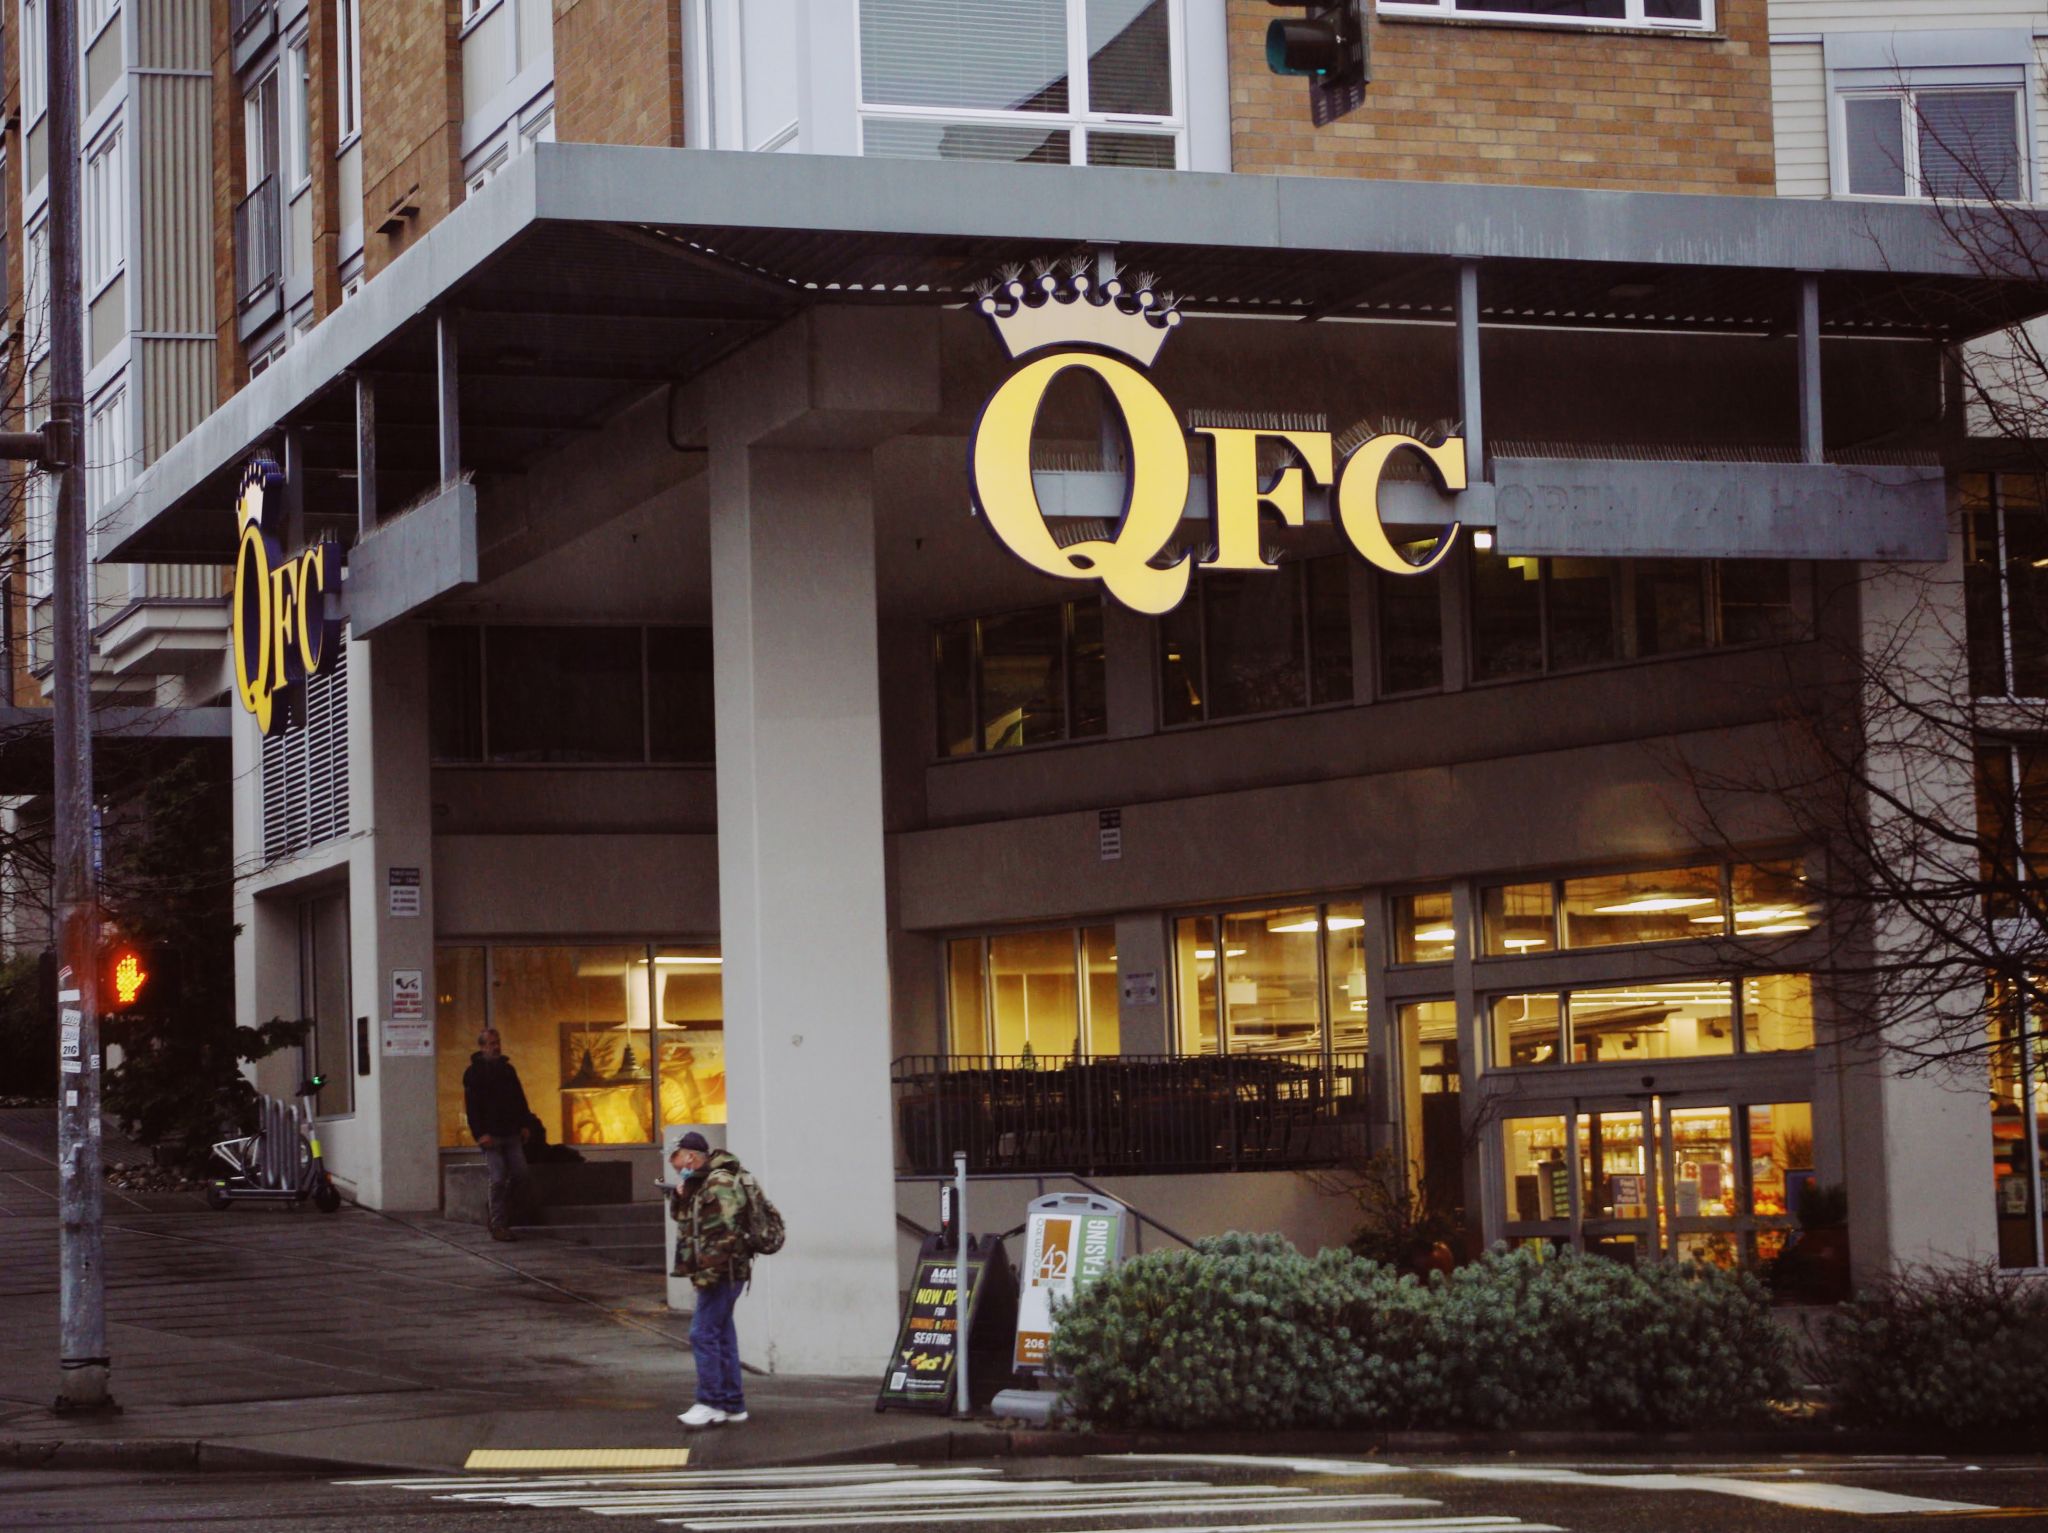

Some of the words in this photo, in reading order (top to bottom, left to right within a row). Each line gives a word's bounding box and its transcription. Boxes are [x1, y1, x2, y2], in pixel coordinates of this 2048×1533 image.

[971, 351, 1467, 615] QFC
[233, 524, 325, 736] QFC
[1040, 1244, 1067, 1279] 42
[931, 1268, 957, 1278] AGAV
[915, 1288, 943, 1305] NOW
[933, 1307, 947, 1317] FOR
[912, 1331, 952, 1345] SEATING
